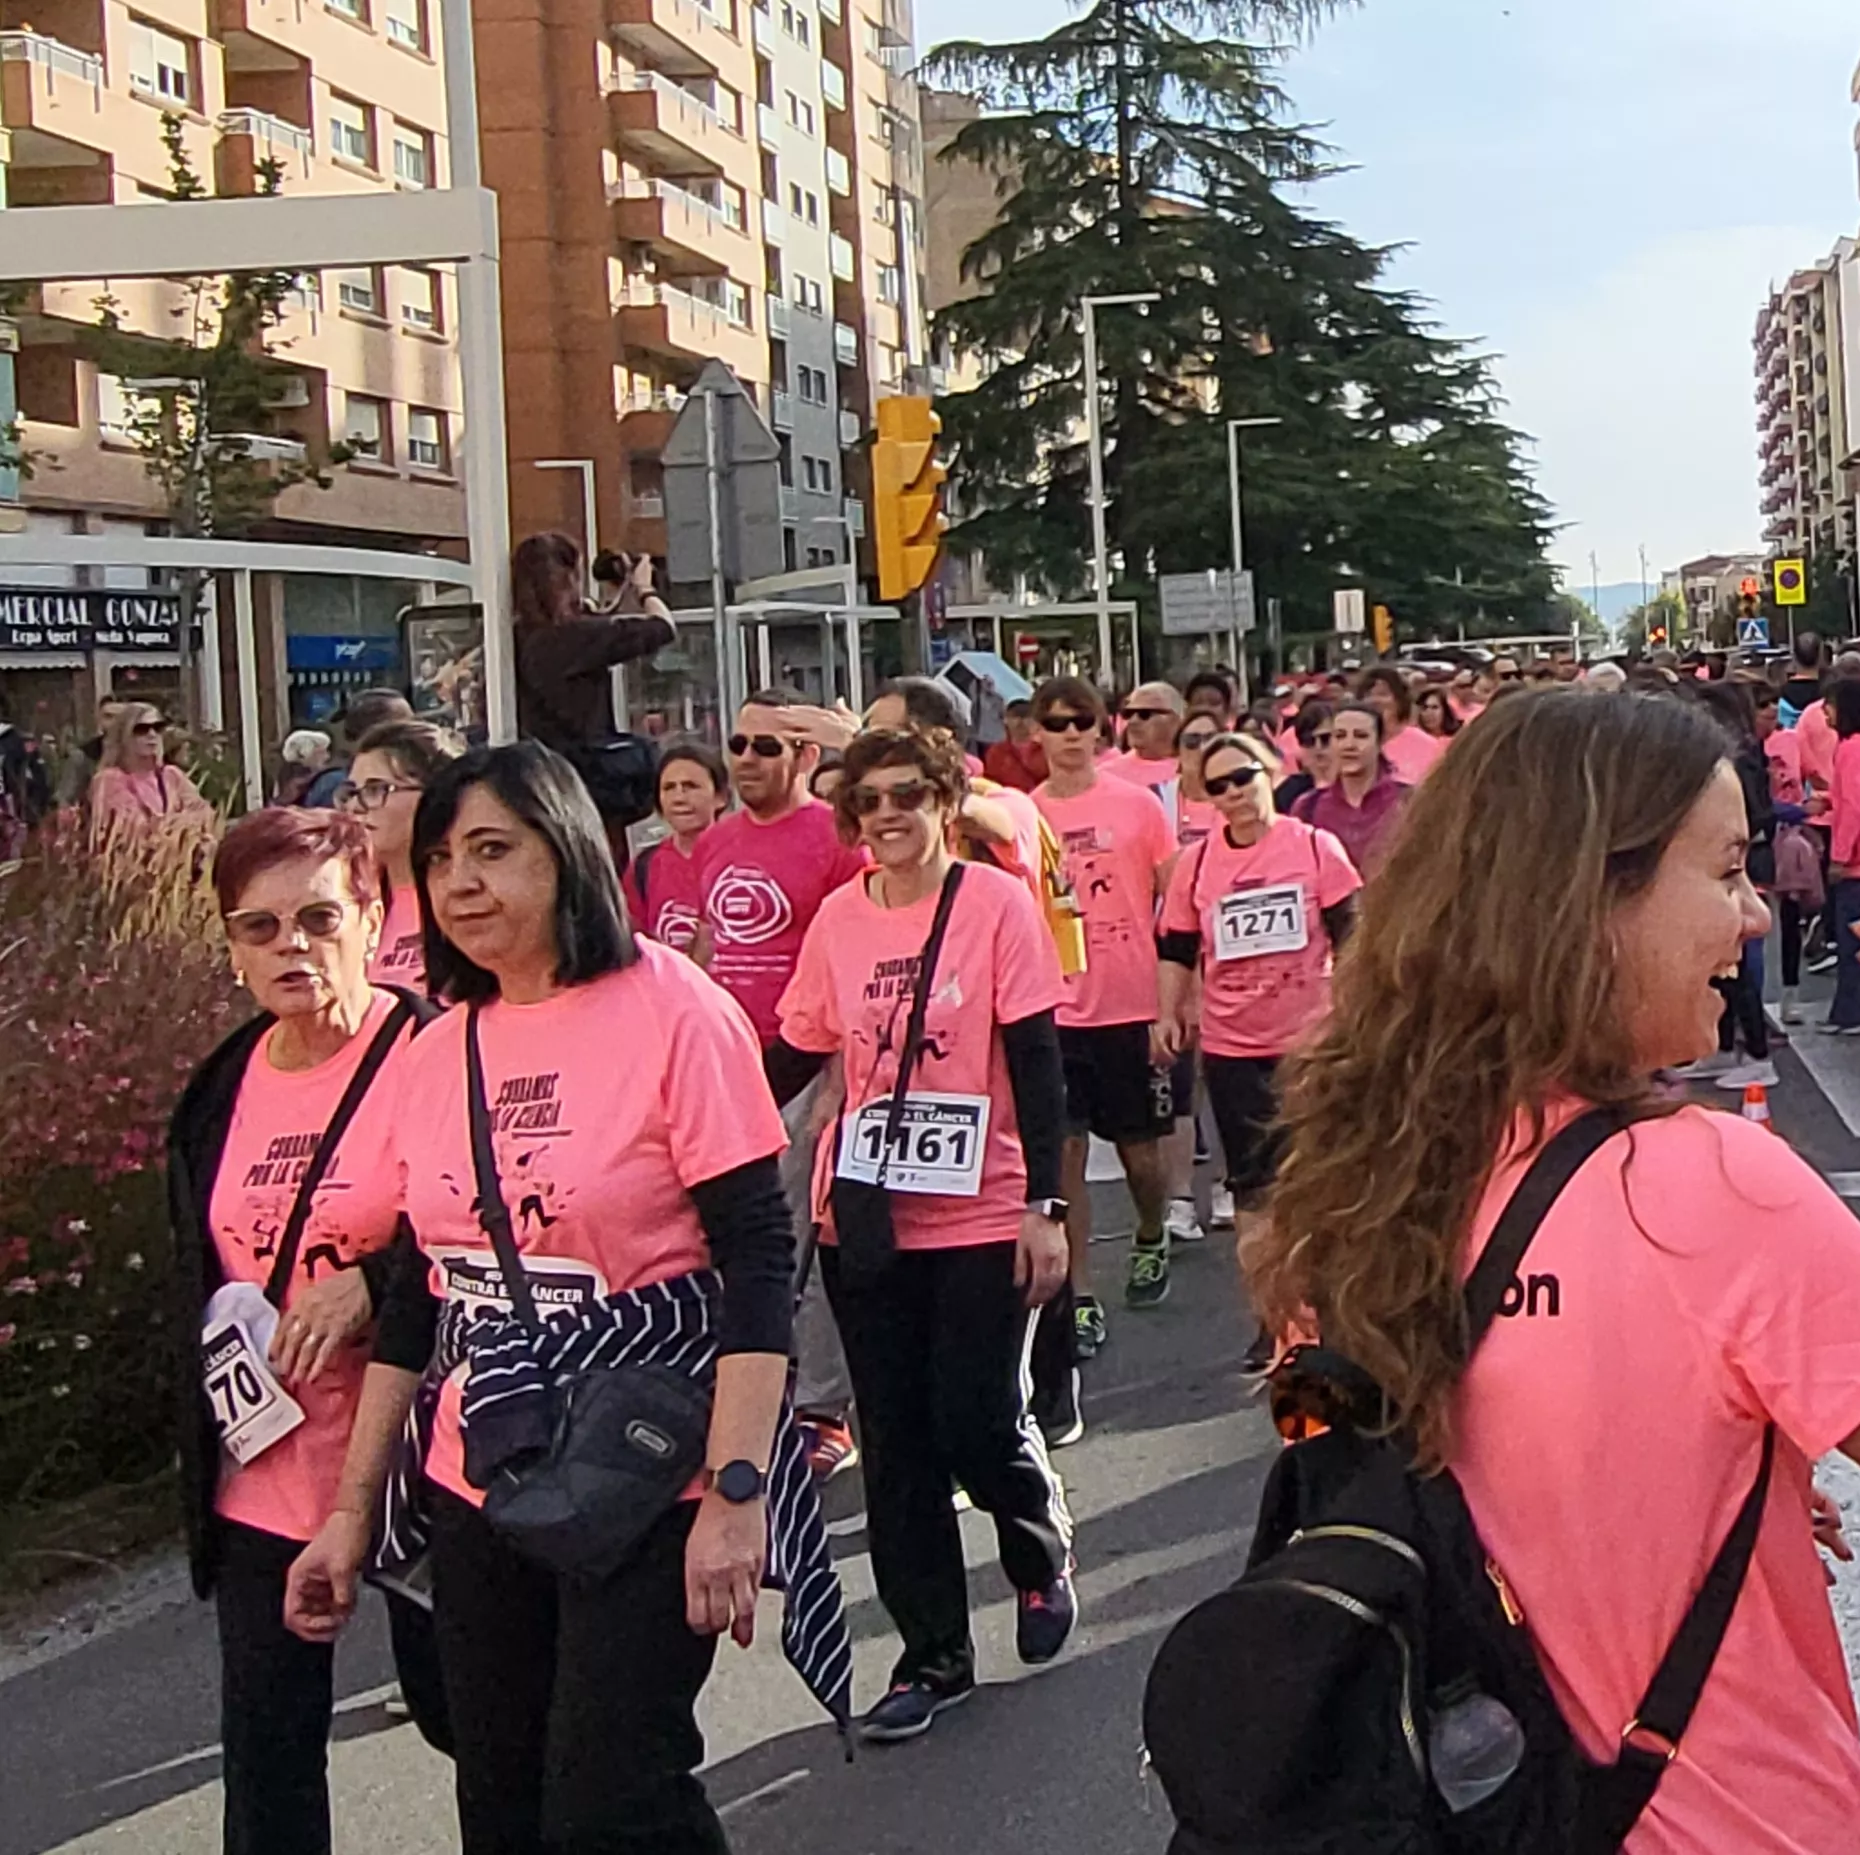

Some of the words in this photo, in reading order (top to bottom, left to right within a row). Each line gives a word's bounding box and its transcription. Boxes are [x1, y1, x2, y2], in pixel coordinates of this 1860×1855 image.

[1224, 907, 1295, 939] 1271
[861, 1124, 969, 1165] 1161
[208, 1360, 264, 1426] 70
